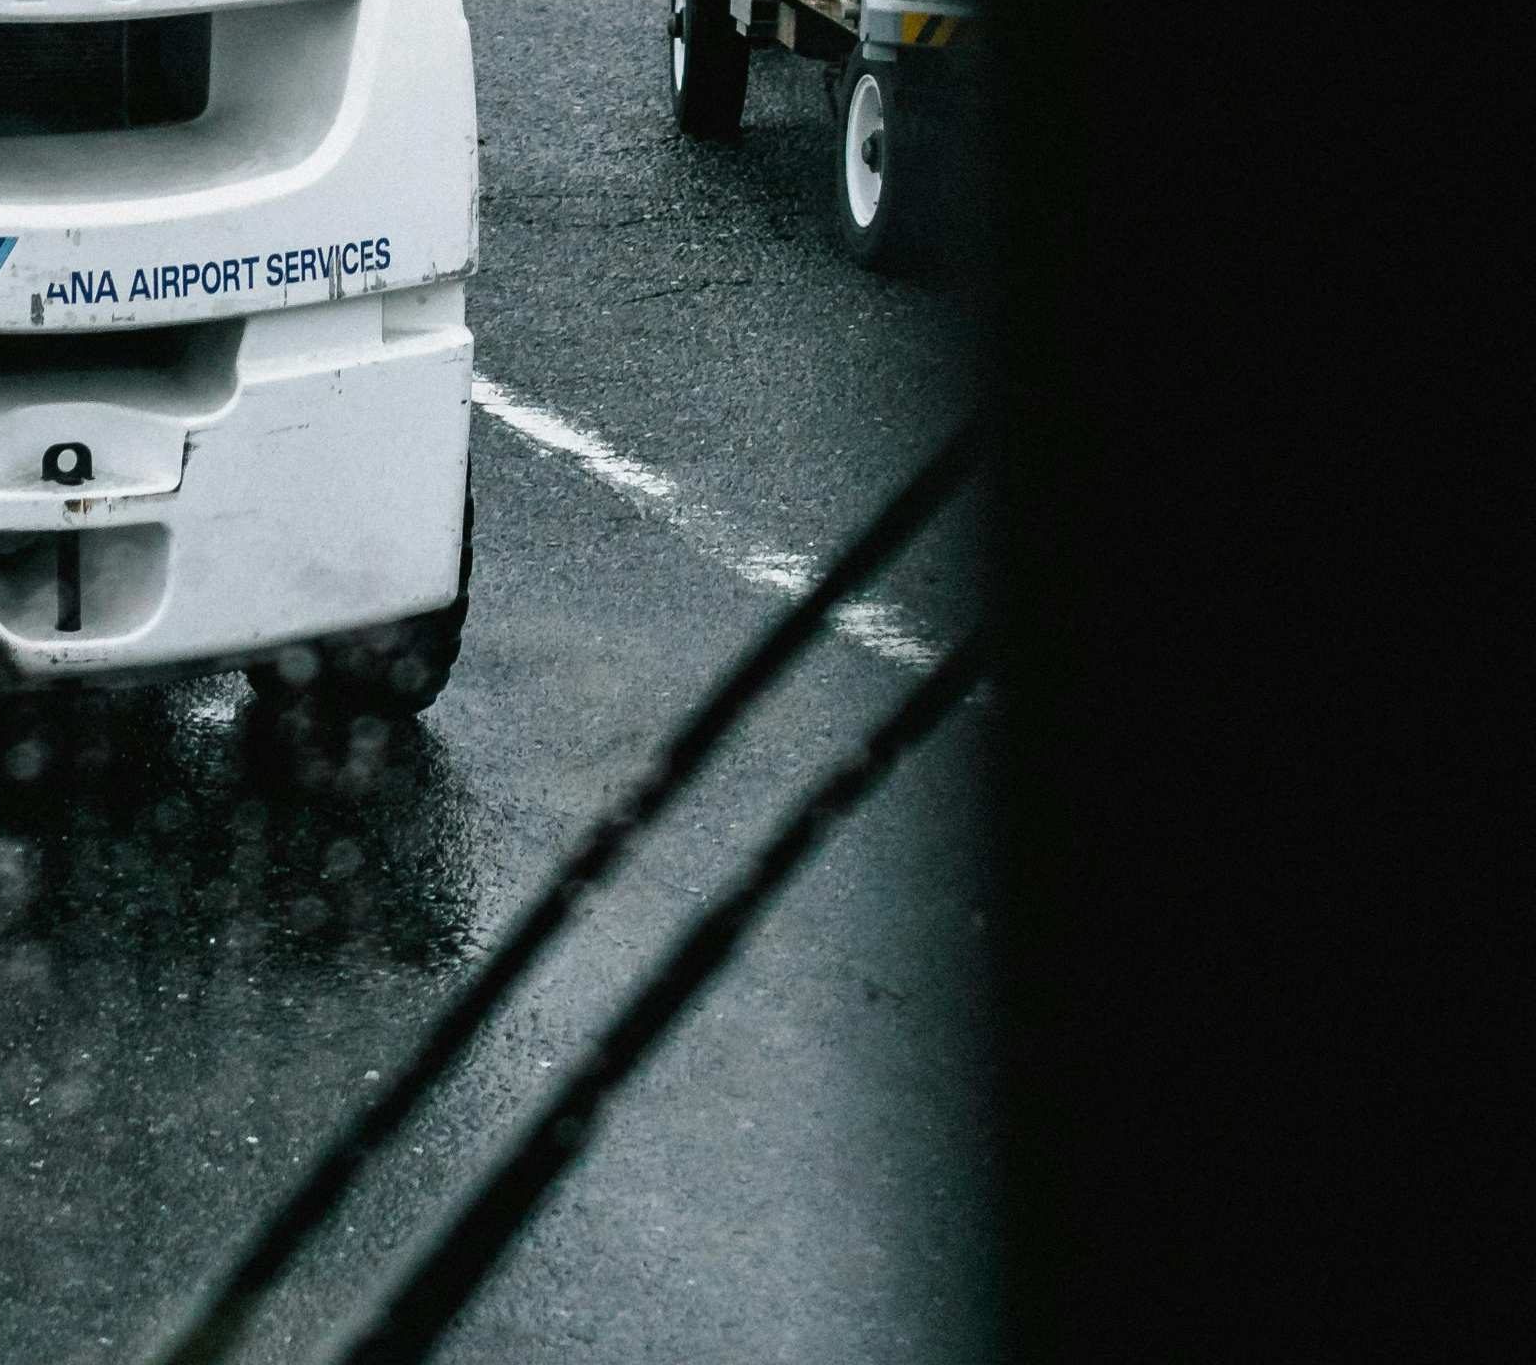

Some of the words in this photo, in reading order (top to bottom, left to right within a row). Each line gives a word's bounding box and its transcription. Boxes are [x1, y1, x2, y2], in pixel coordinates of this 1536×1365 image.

[47, 270, 119, 305] ANA
[129, 255, 260, 302] AIRPORT
[266, 236, 392, 287] SERVICES
